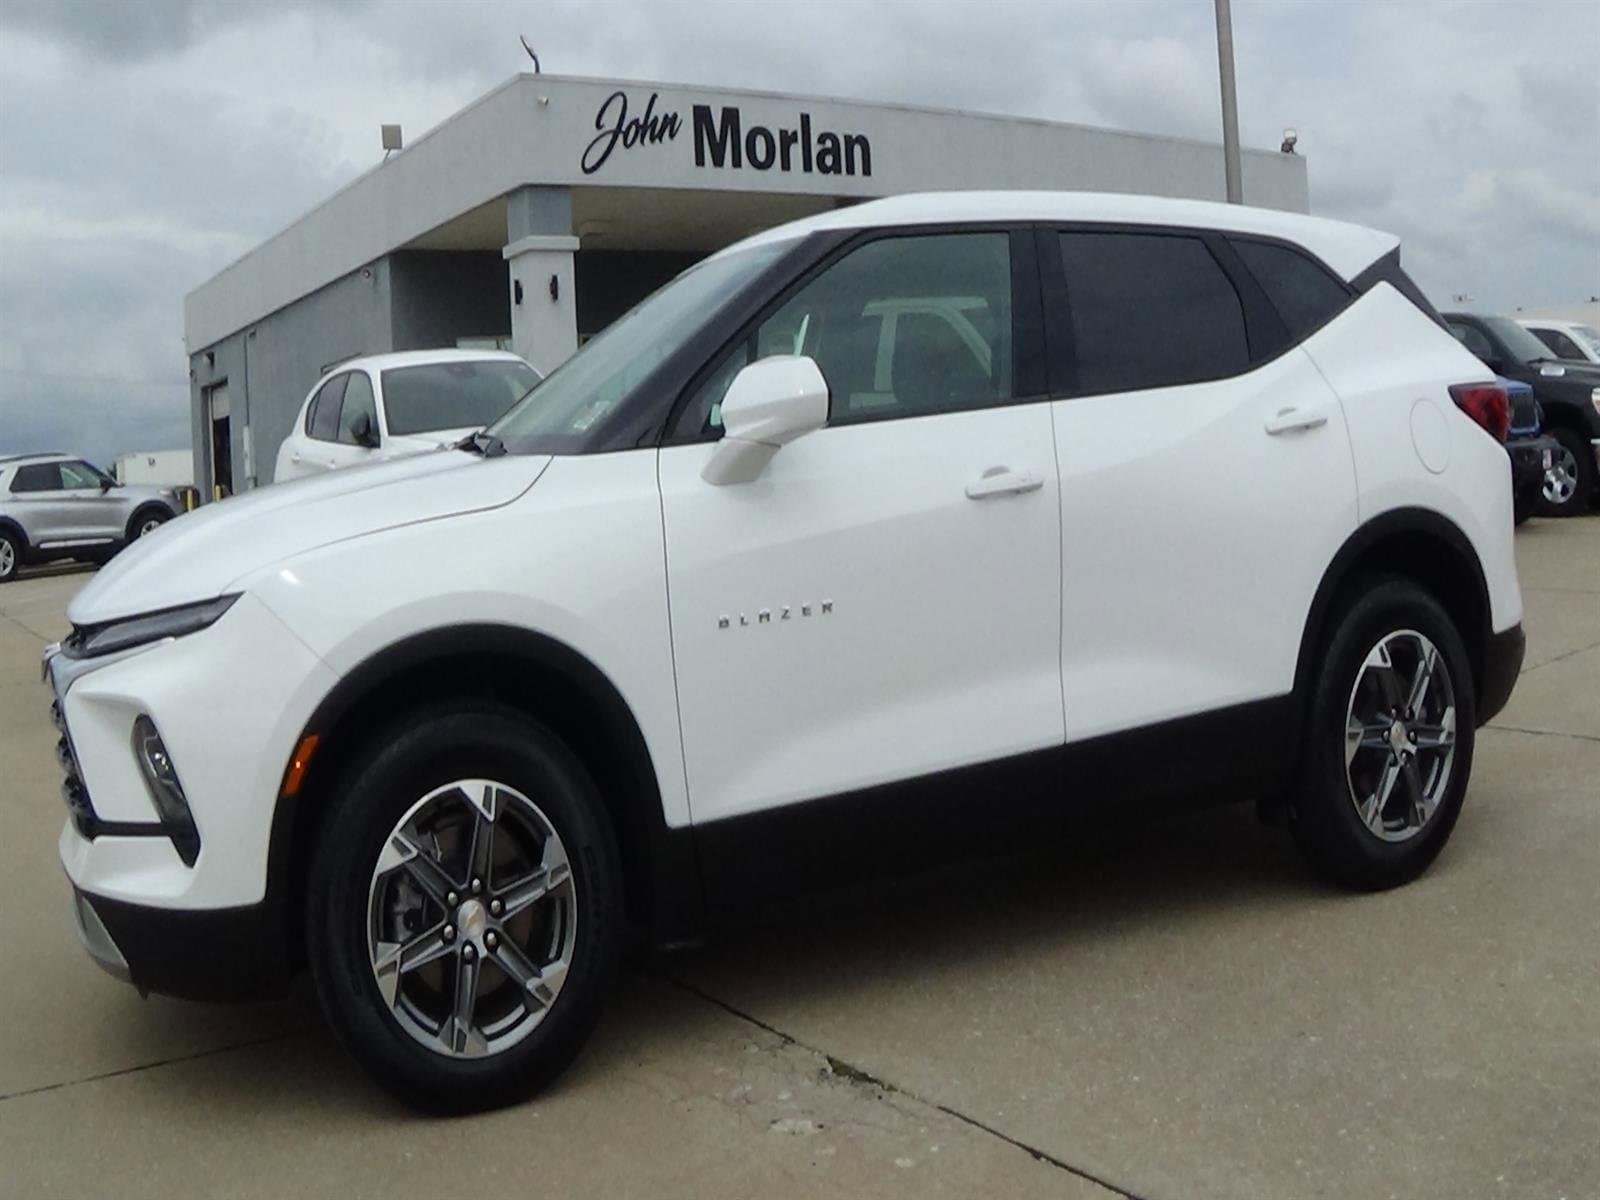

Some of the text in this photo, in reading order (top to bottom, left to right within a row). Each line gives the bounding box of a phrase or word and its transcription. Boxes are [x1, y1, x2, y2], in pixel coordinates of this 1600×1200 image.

[581, 91, 872, 178] John Morlan
[717, 599, 835, 630] BLAZER
